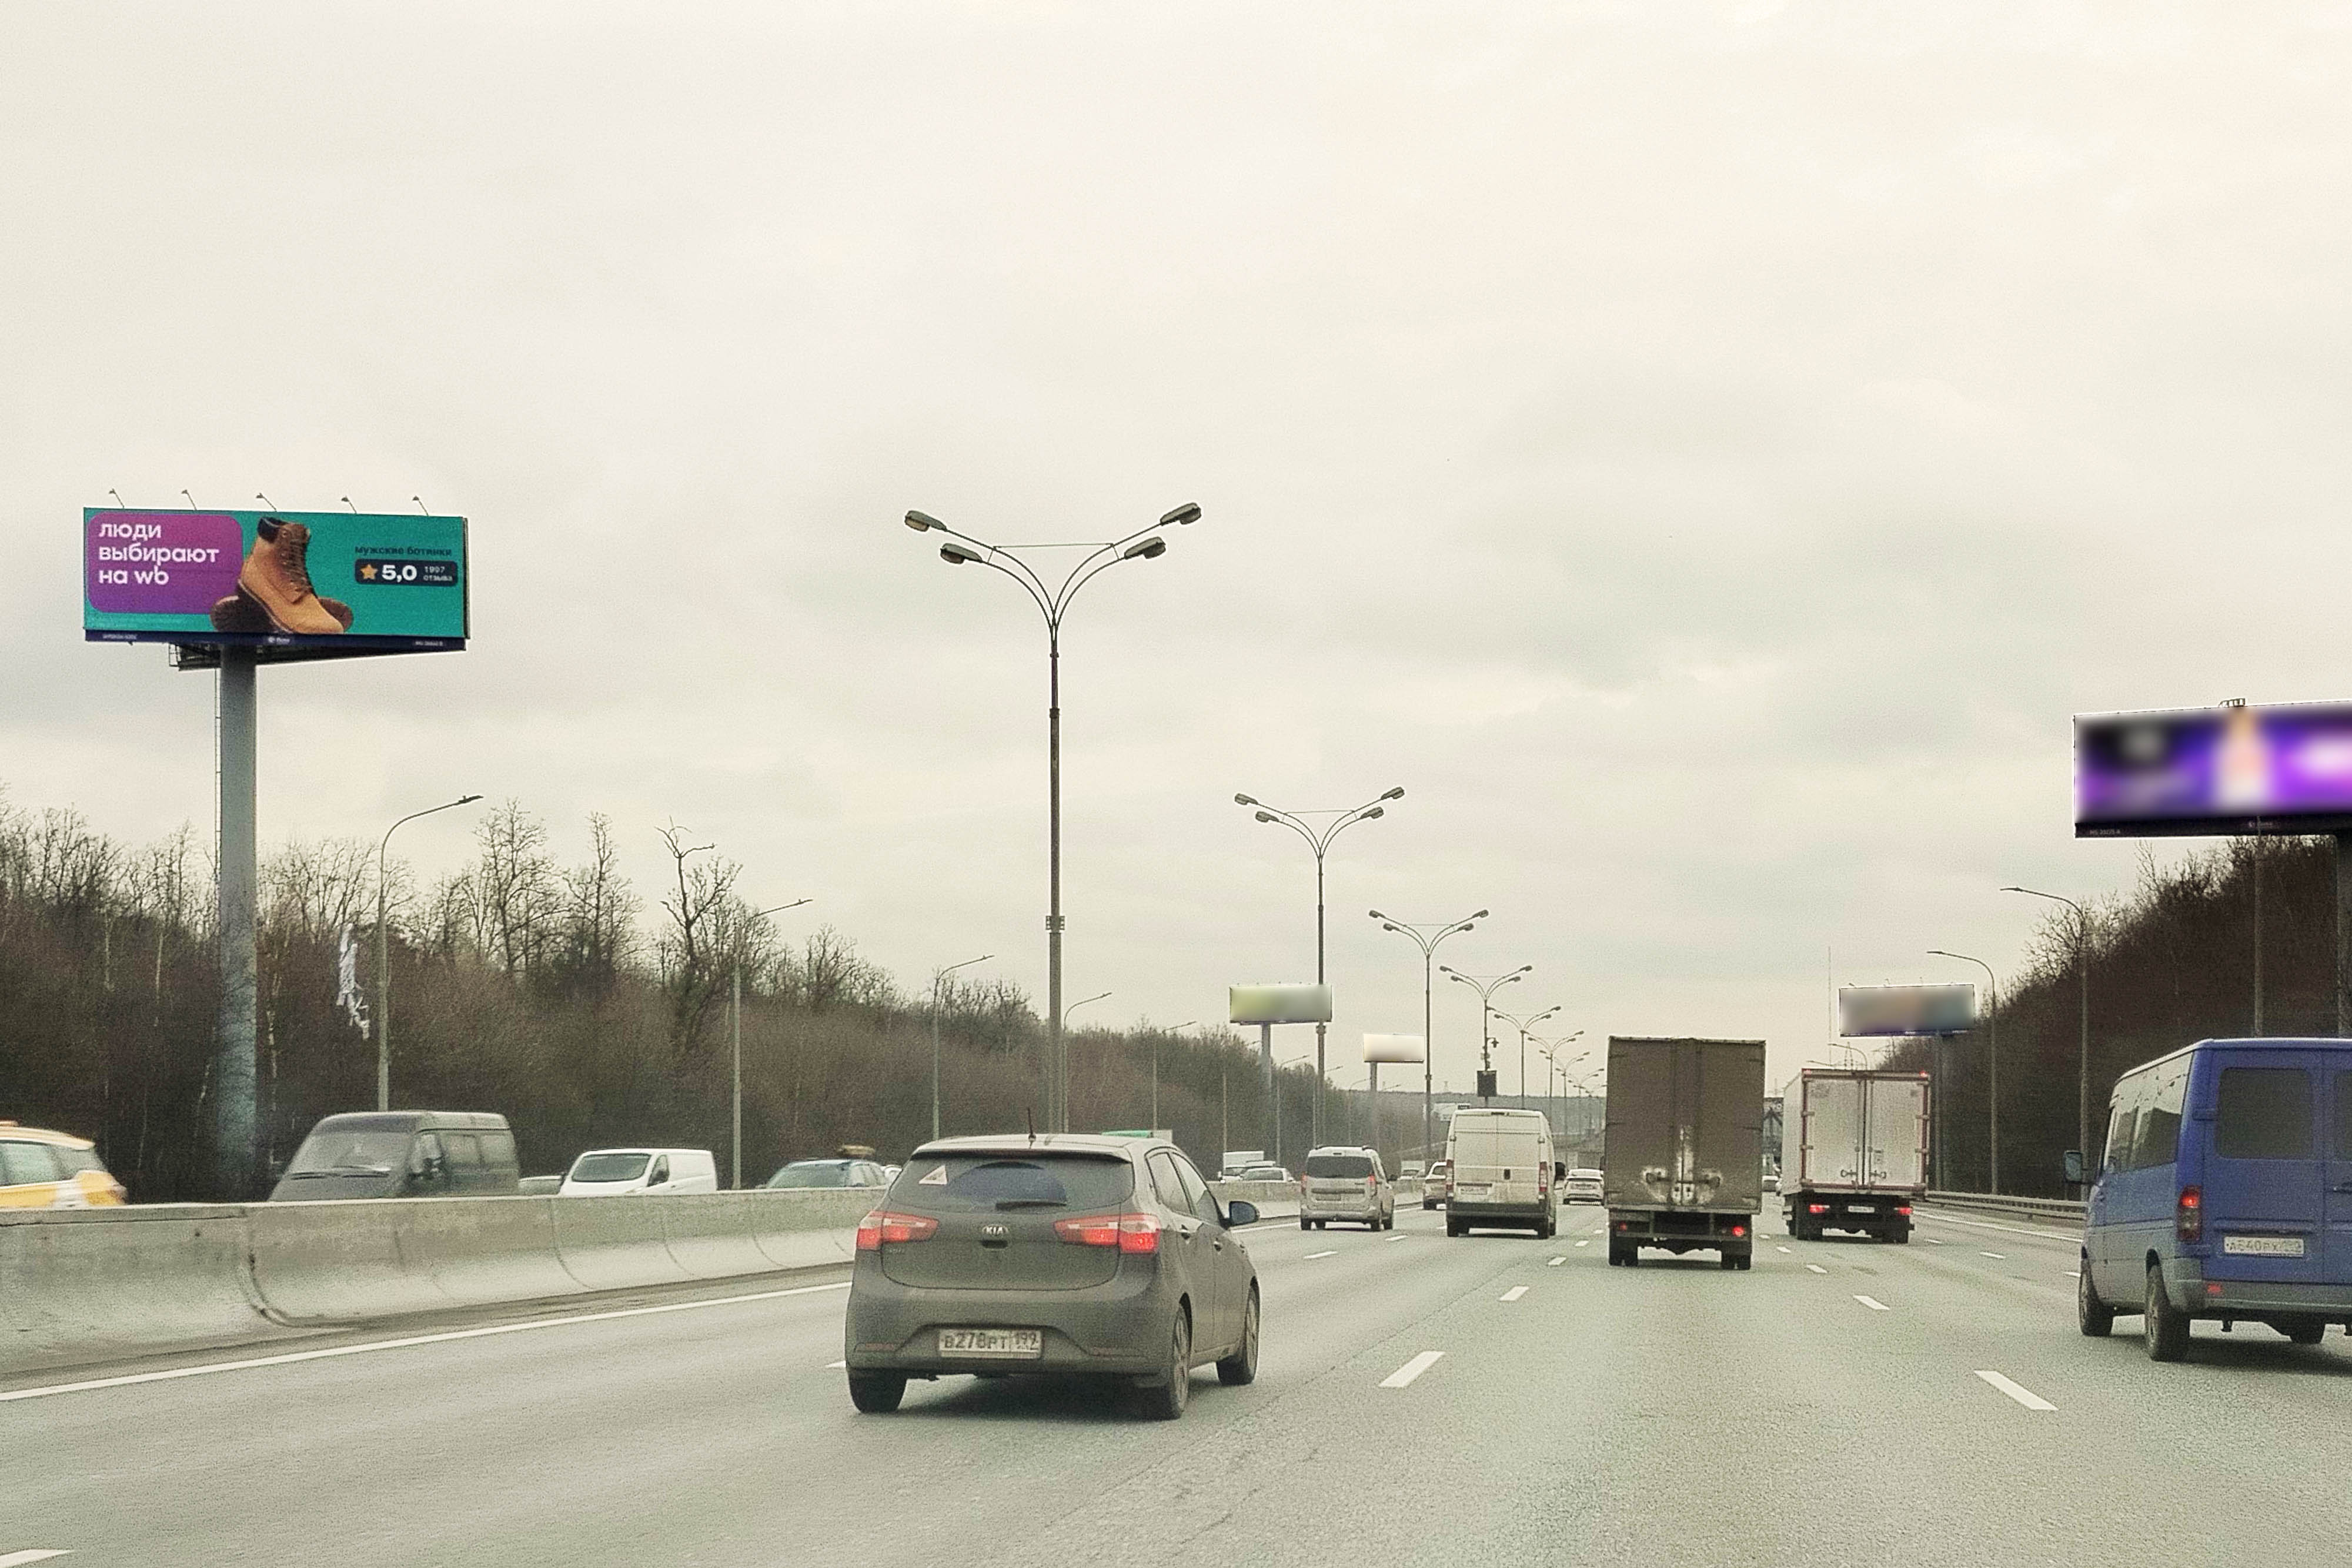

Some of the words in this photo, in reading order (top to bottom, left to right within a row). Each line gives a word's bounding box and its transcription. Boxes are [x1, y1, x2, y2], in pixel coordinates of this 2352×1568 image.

[99, 523, 161, 541] люди
[99, 542, 219, 566] выбирают
[355, 546, 404, 556] мужские
[407, 547, 452, 556] ботинки
[99, 570, 128, 584] на
[134, 564, 169, 584] wb
[382, 564, 417, 583] 5,0
[985, 1226, 1005, 1235] KIA
